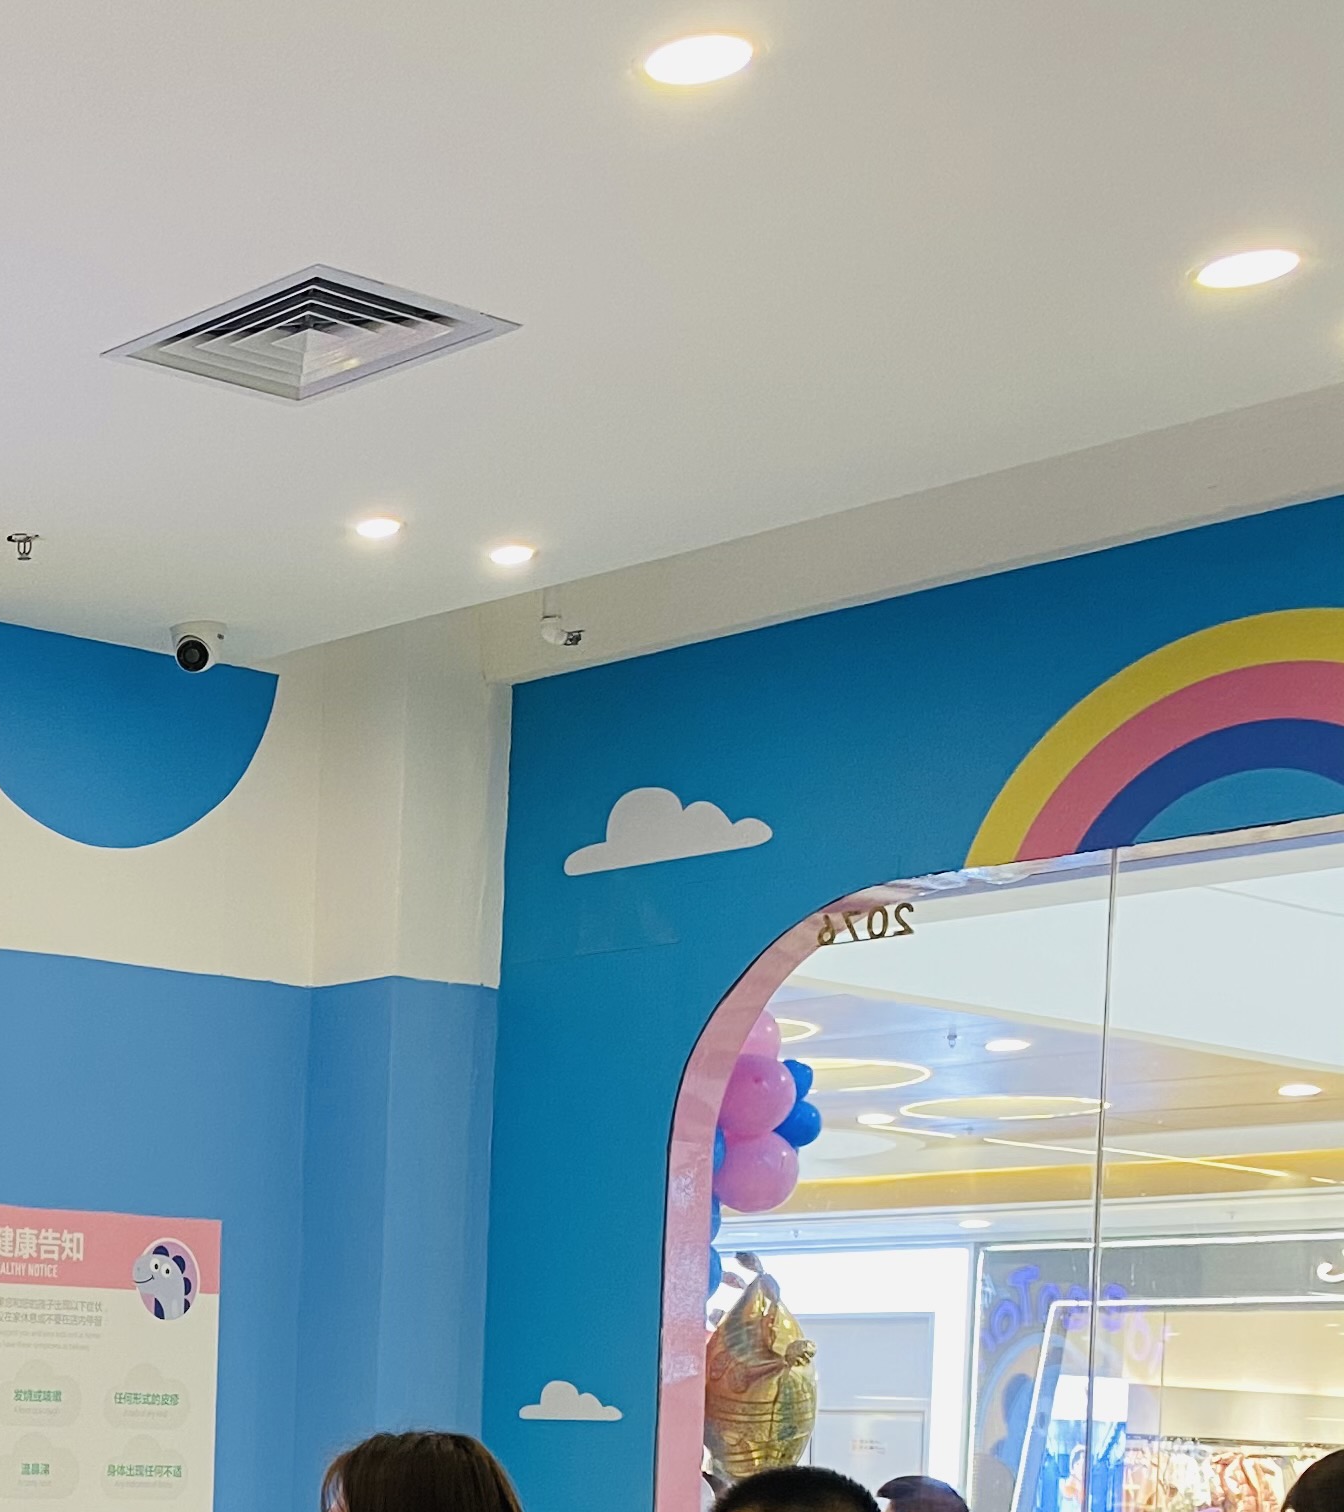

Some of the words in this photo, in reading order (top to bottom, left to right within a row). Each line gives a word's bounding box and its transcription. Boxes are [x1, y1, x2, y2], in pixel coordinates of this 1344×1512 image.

[28, 1264, 58, 1278] NOTICE
[114, 1391, 179, 1406] 任何形式的皮疹
[107, 1464, 182, 1478] 身体出现任何不适
